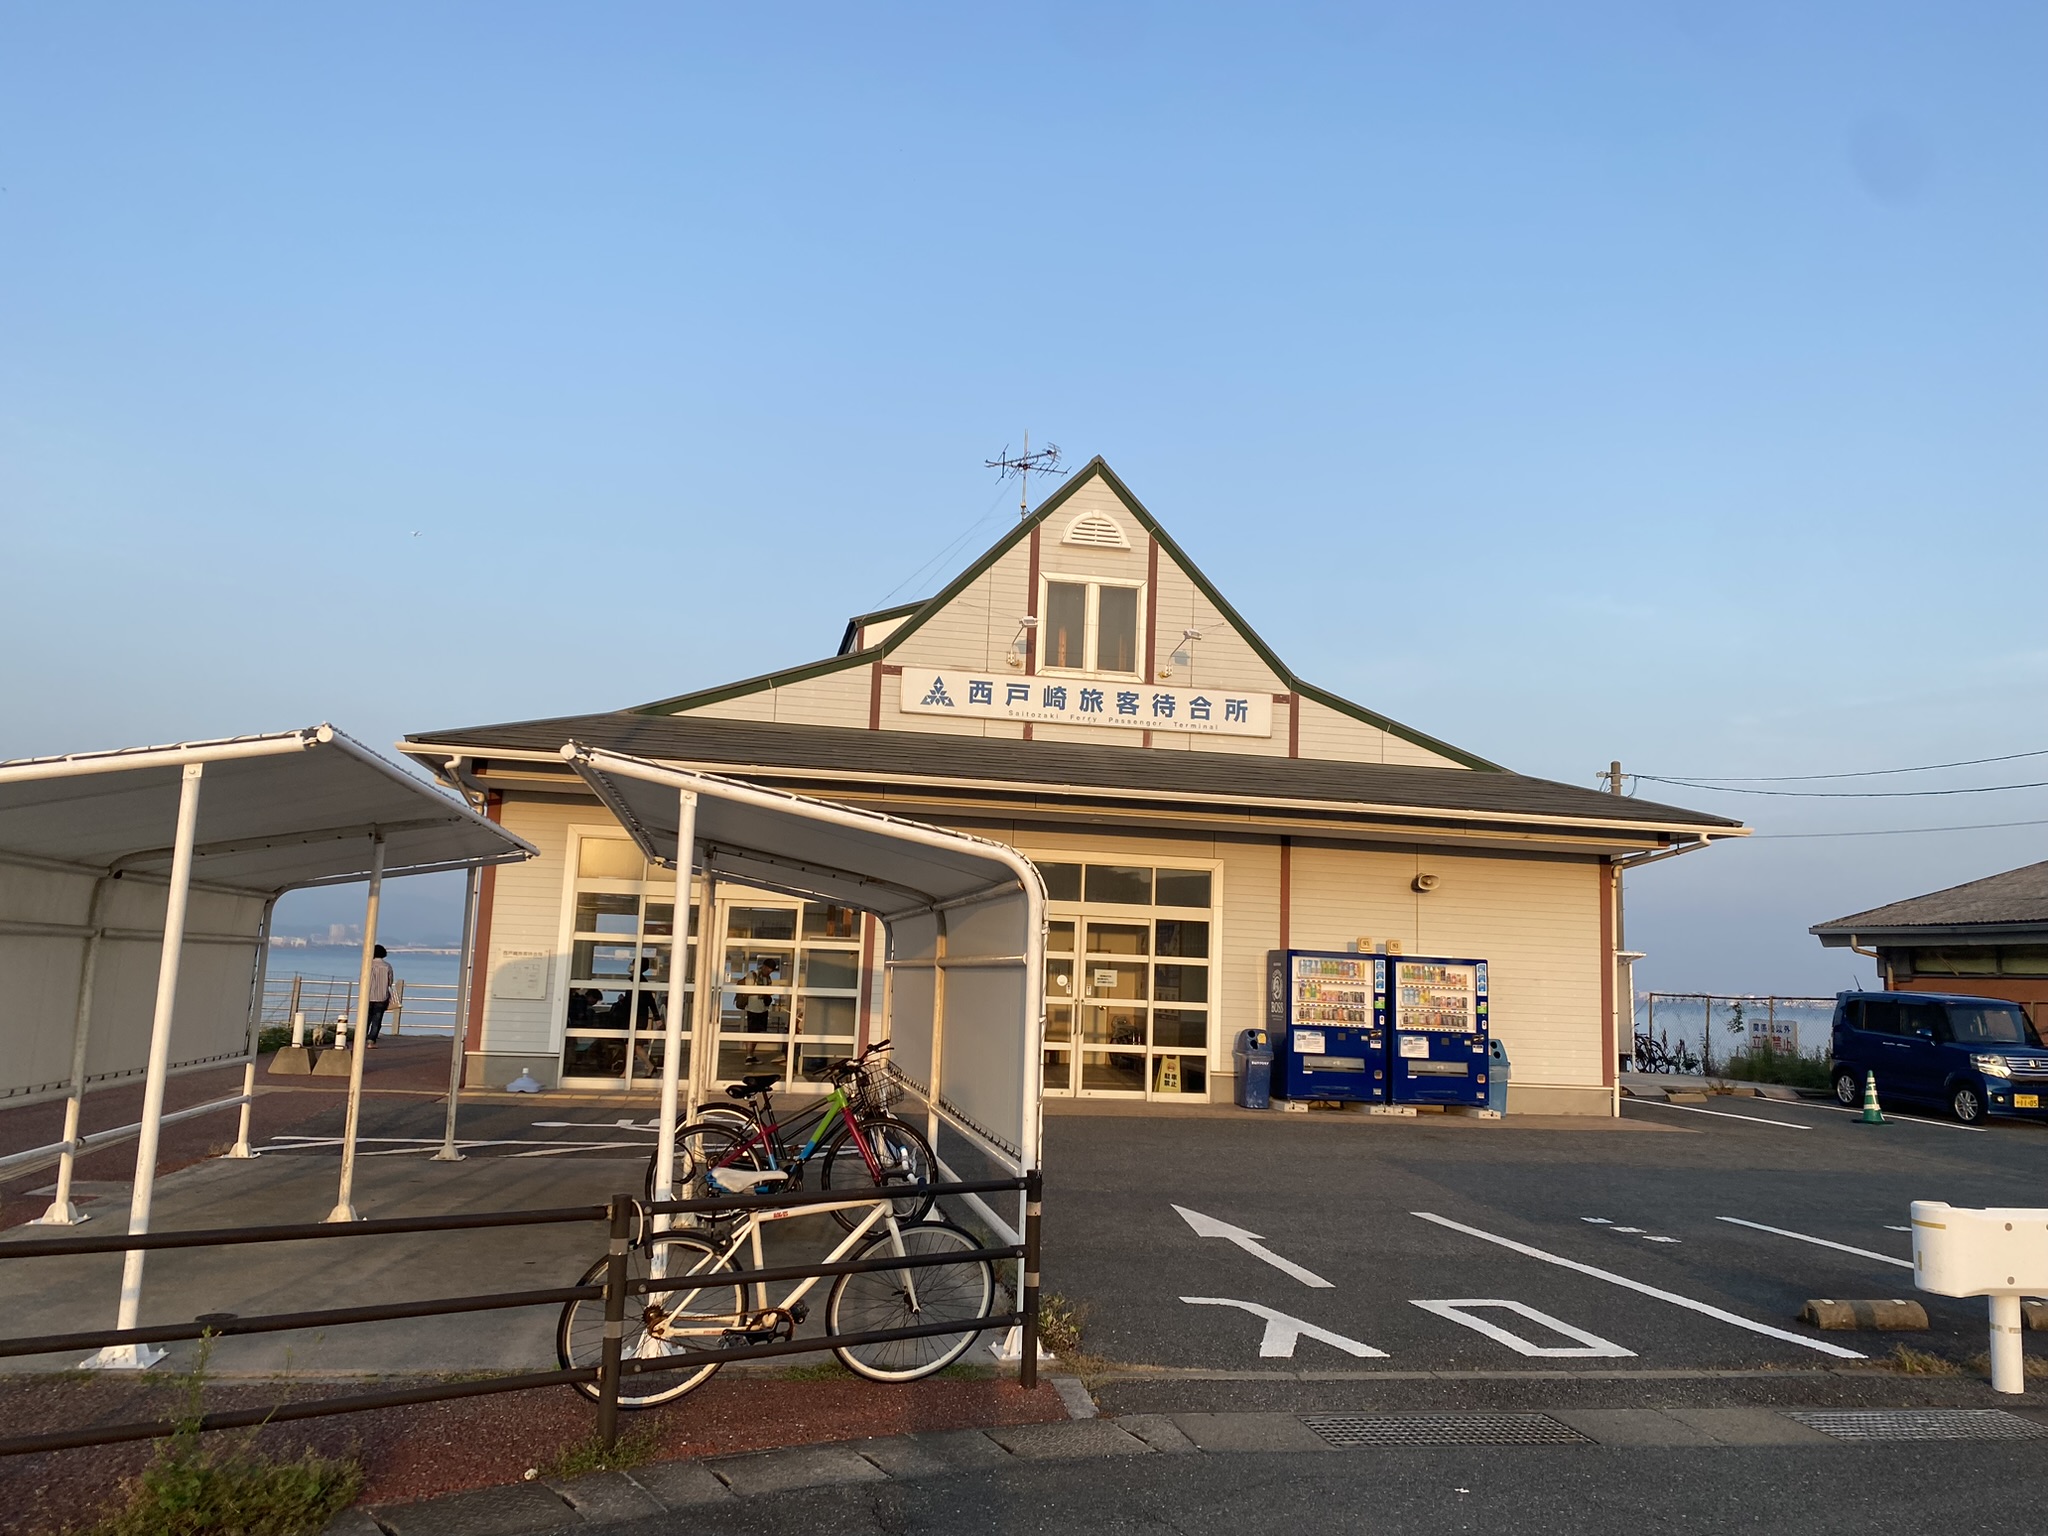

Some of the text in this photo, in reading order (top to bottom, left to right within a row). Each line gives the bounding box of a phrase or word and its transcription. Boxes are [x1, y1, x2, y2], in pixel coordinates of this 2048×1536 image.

[968, 680, 1248, 723] 西戸崎旅客待合所
[1008, 709, 1218, 730] Saitozaki Ferry Passenger Terminal
[1271, 1001, 1284, 1013] BOSS
[1753, 1023, 1791, 1034] 関係以外
